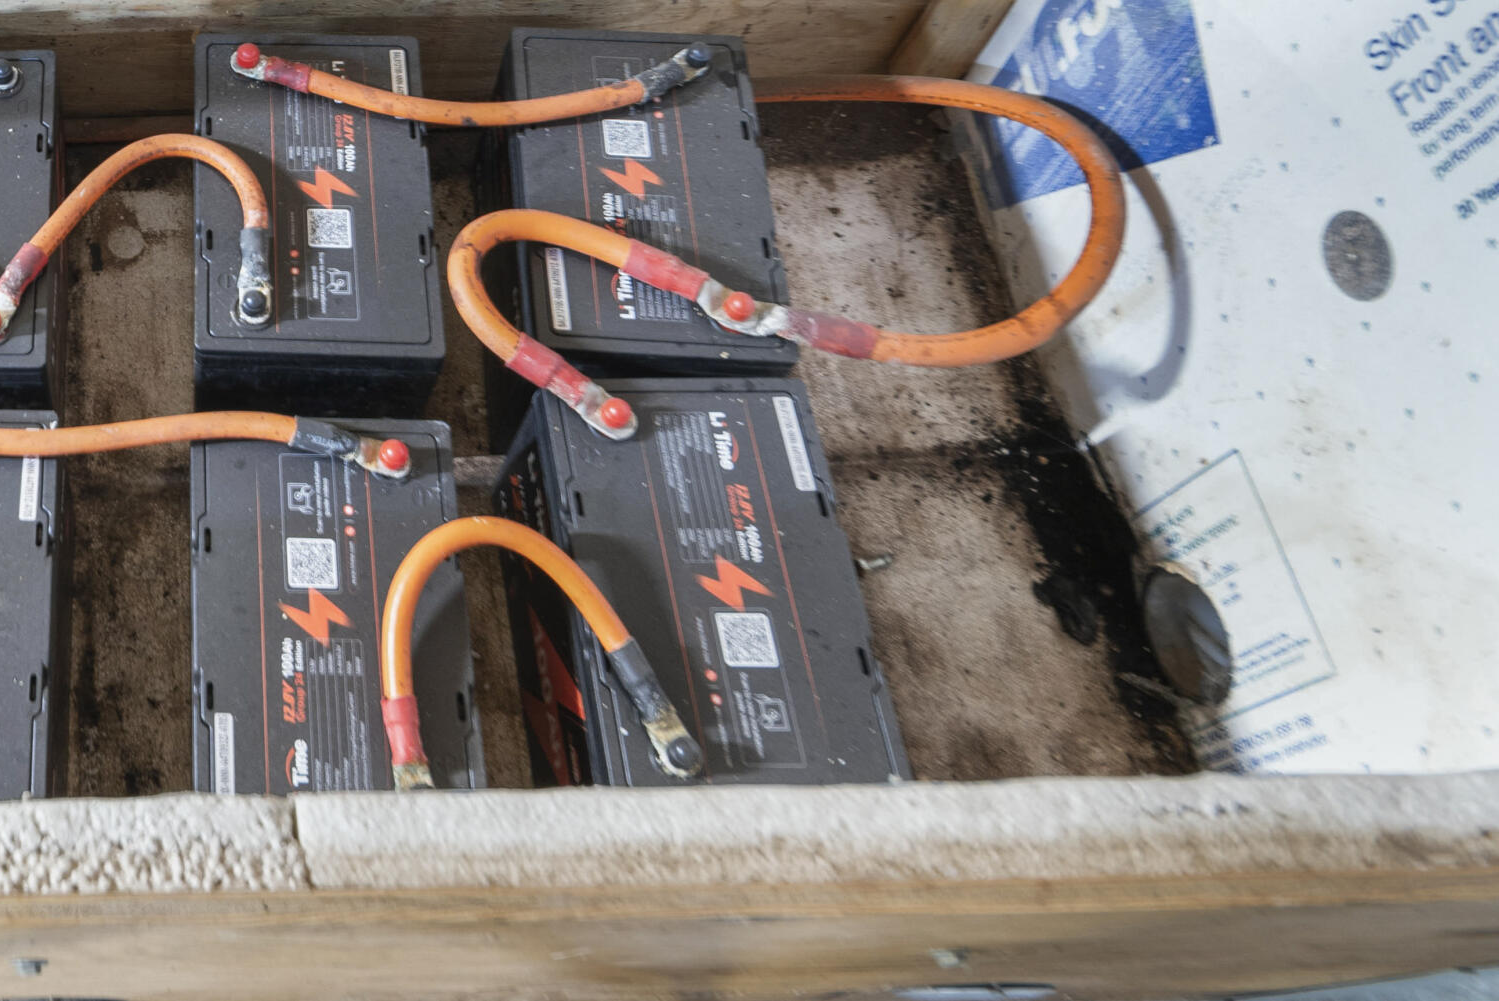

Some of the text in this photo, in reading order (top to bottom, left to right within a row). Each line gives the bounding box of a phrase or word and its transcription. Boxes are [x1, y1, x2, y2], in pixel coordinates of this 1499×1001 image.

[1364, 10, 1430, 73] Skin
[332, 61, 345, 71] Li
[1386, 40, 1470, 119] Front
[344, 144, 356, 172] 100Ah
[602, 193, 615, 222] 100Ah
[619, 305, 636, 319] Li
[708, 411, 735, 470] Li Time
[743, 524, 764, 563] 100Ah
[295, 640, 304, 671] Edition
[281, 637, 296, 724] 12.8V 100Ah
[296, 686, 307, 723] Group
[292, 738, 310, 787] Time
